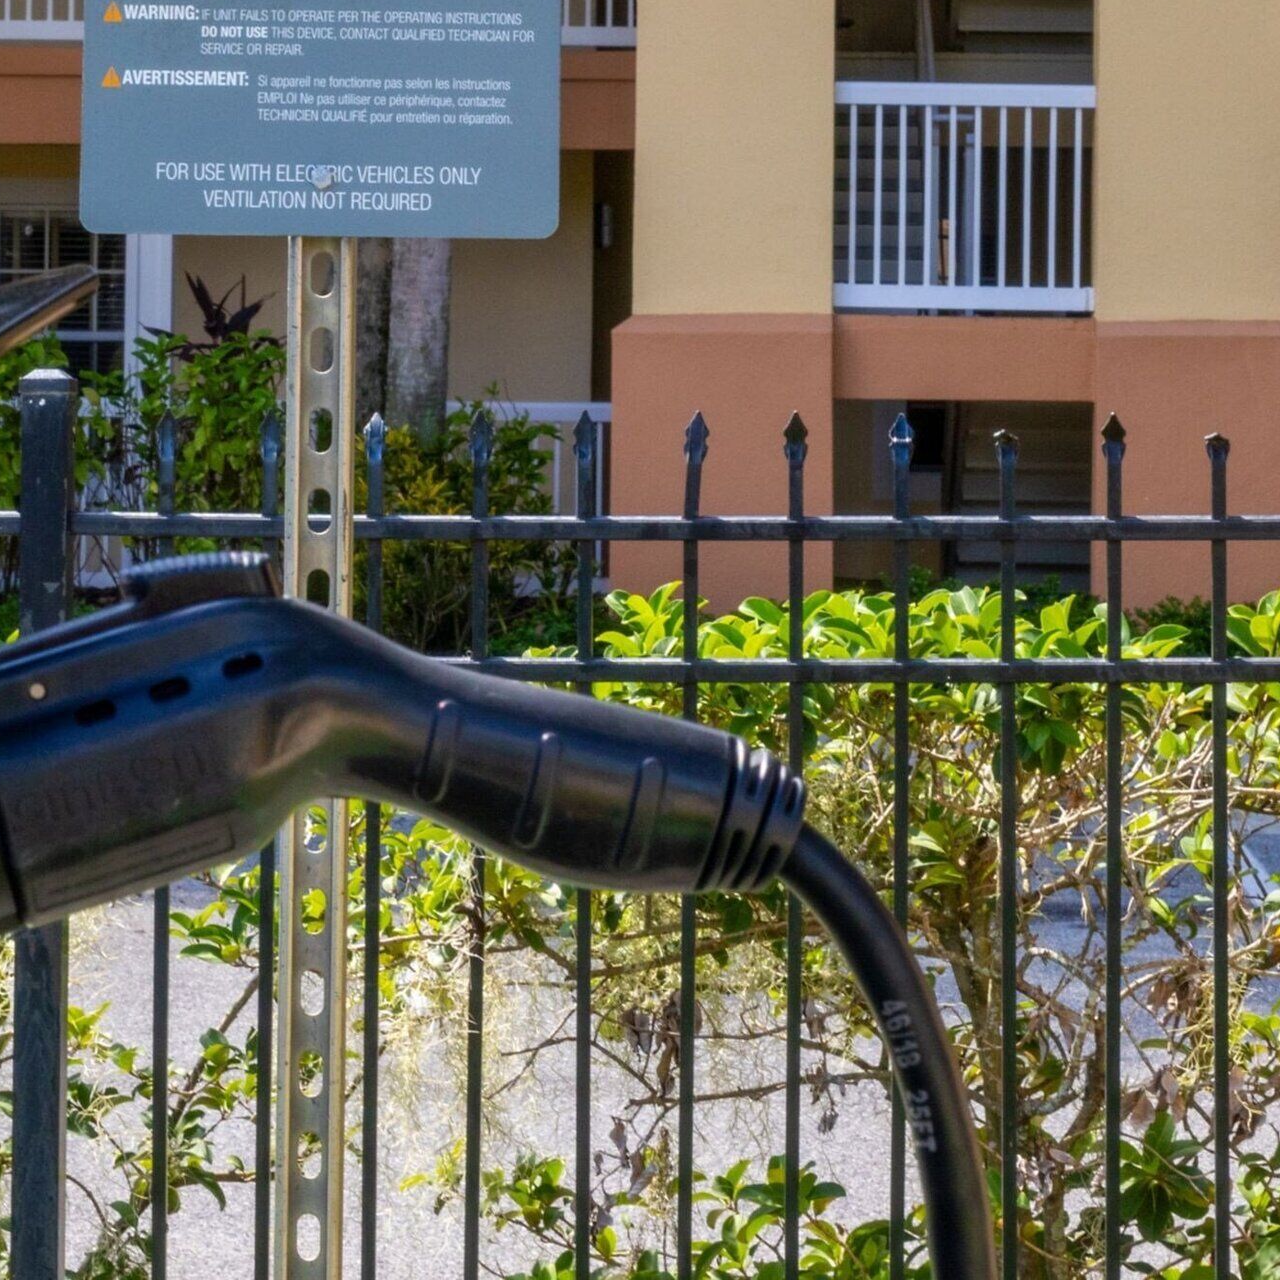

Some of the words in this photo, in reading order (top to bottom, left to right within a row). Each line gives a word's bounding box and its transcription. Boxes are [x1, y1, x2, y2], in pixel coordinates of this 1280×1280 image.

[123, 4, 199, 20] WARNING:
[122, 69, 248, 86] AVERTISSEMENT:
[155, 162, 189, 180] FOR
[193, 162, 225, 181] USE
[228, 163, 271, 181] WITH
[275, 163, 353, 186] ELECRIC
[356, 165, 434, 184] VEHICLES
[439, 166, 481, 185] ONLY
[203, 190, 306, 208] VENTILATION
[311, 191, 346, 209] NOT
[350, 192, 431, 211] REQUIRED
